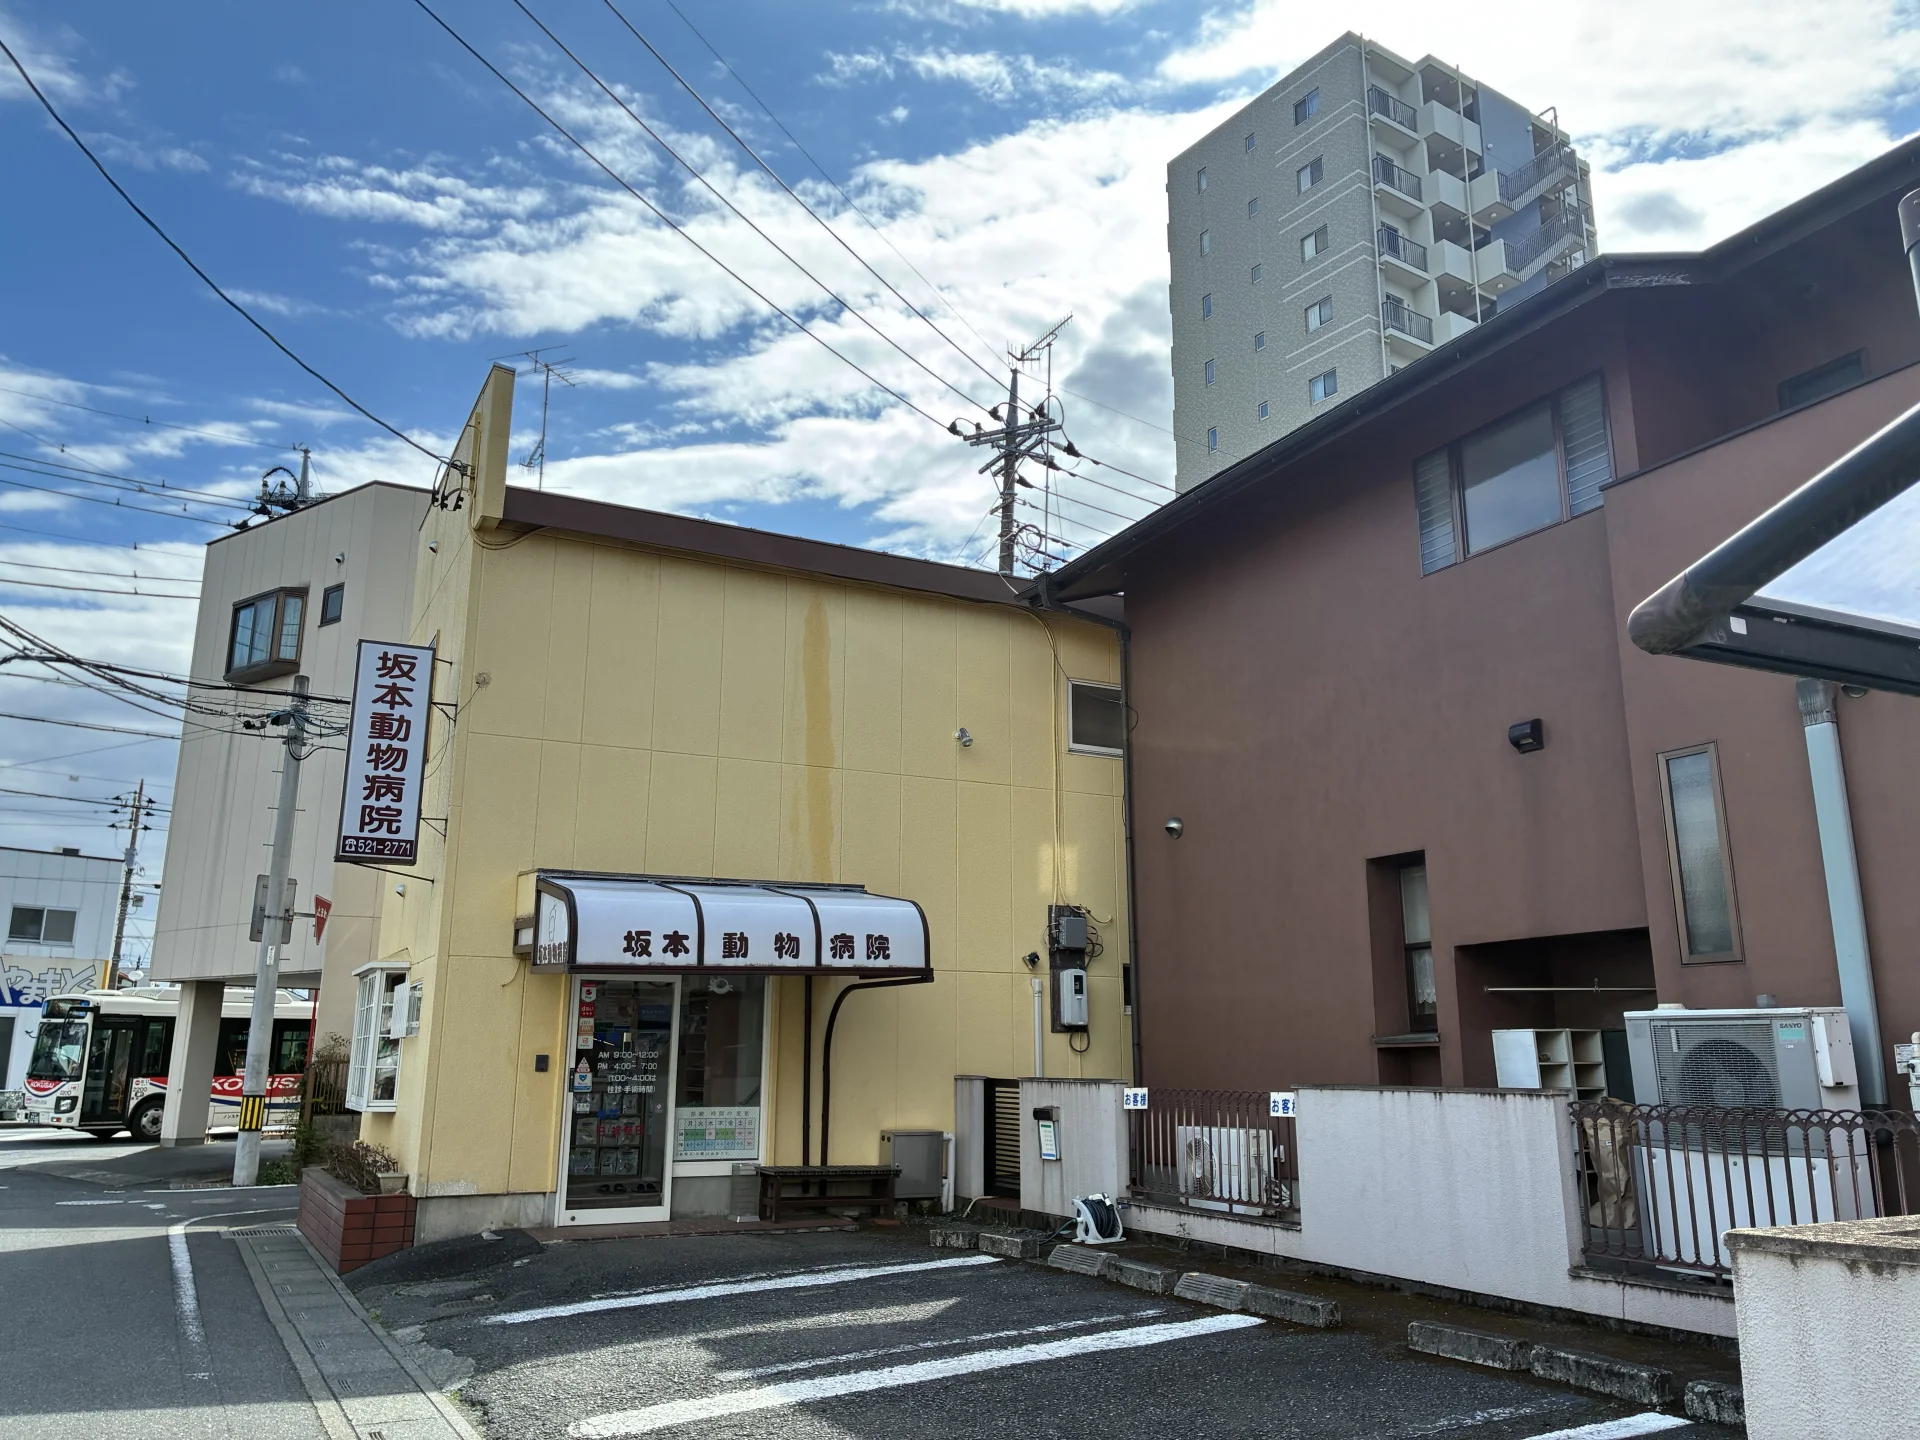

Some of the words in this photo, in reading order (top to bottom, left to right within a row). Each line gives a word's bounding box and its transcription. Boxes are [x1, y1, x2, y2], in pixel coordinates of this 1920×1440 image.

[358, 650, 418, 835] 坂本動物病院
[357, 838, 411, 857] 521-2771
[622, 930, 891, 960] 坂本動物病院
[598, 1051, 610, 1059] AM
[597, 1062, 608, 1070] PM
[1124, 1092, 1147, 1106] お客様
